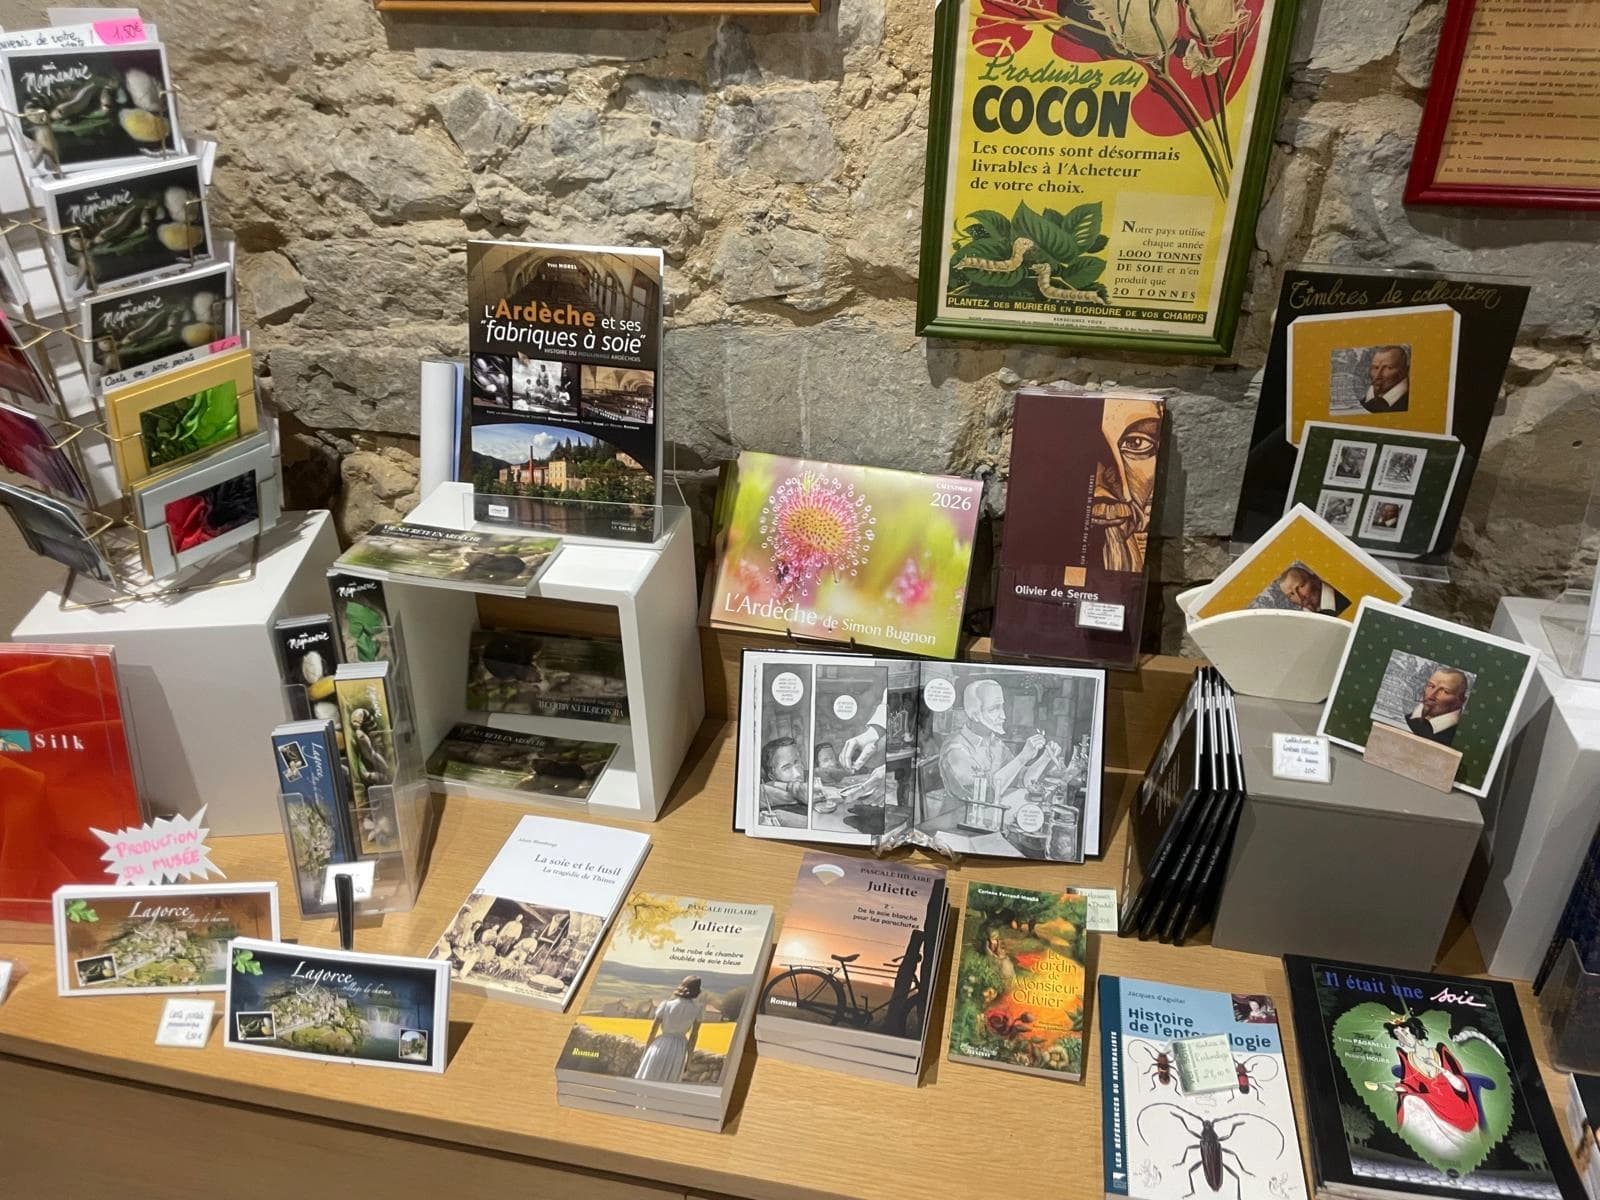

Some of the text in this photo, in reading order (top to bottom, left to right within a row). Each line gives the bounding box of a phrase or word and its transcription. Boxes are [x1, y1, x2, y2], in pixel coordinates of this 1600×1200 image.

[975, 44, 1145, 88] Produisez du
[972, 84, 1132, 138] COCON
[972, 142, 1181, 161] Les cocons sont désormais
[971, 160, 1142, 179] livrables à l'Acheteur
[970, 178, 1085, 195] de votre choix.
[1122, 220, 1206, 238] Notre pays utilise
[1142, 238, 1204, 250] chaque année
[1156, 251, 1203, 262] TONNES
[1117, 263, 1200, 277] DE SOIE et n'en
[1114, 275, 1167, 288] produit que
[1112, 287, 1197, 300] 20 TONNES
[1289, 279, 1503, 310] Timbres de collection
[485, 298, 642, 332] L'Ardèche et ses
[947, 297, 1204, 323] PLANTEZ DES MURIERS EN BORDURE DE VOS CHAMPS
[584, 329, 596, 349] à
[929, 491, 972, 512] 2026
[1015, 584, 1099, 601] Olivier de Serres
[725, 592, 937, 646] L'Ardèche de Simon Bugnon
[34, 733, 85, 751] Silk
[115, 829, 199, 858] PRODUCTION
[123, 849, 200, 879] DU MUSÉE
[533, 853, 622, 877] La soie et le fusil
[542, 866, 552, 874] La
[553, 868, 580, 879] tragédie
[860, 866, 933, 884] PASCALE HILAIRE
[866, 880, 920, 898] Juliette
[128, 900, 193, 930] Lagorce
[687, 904, 760, 916] PASCALE HILAIRE
[857, 906, 867, 914] De
[875, 909, 890, 918] soie
[891, 911, 918, 922] blanche
[691, 920, 743, 935] Juliette
[852, 914, 920, 930] pour les parachutes
[669, 954, 743, 967] doublée de soie bleue
[672, 946, 745, 959] Une robe de chambre
[1047, 950, 1061, 961] Le
[1031, 959, 1077, 975] Jardin
[291, 961, 356, 996] Lagorce
[1014, 974, 1079, 996] Monsieur
[1047, 972, 1060, 981] de
[1128, 990, 1186, 1006] Jacques d'Aguilar
[1324, 970, 1487, 1008] Il était une soie
[769, 996, 798, 1008] Roman
[1011, 989, 1065, 1009] Olivier
[1128, 1007, 1194, 1028] Histoire
[1128, 1018, 1272, 1052] de l'entlogie
[571, 1047, 600, 1058] Roman
[1110, 1031, 1123, 1168] LES RÉFÉRENCES DU NATURALISTE
